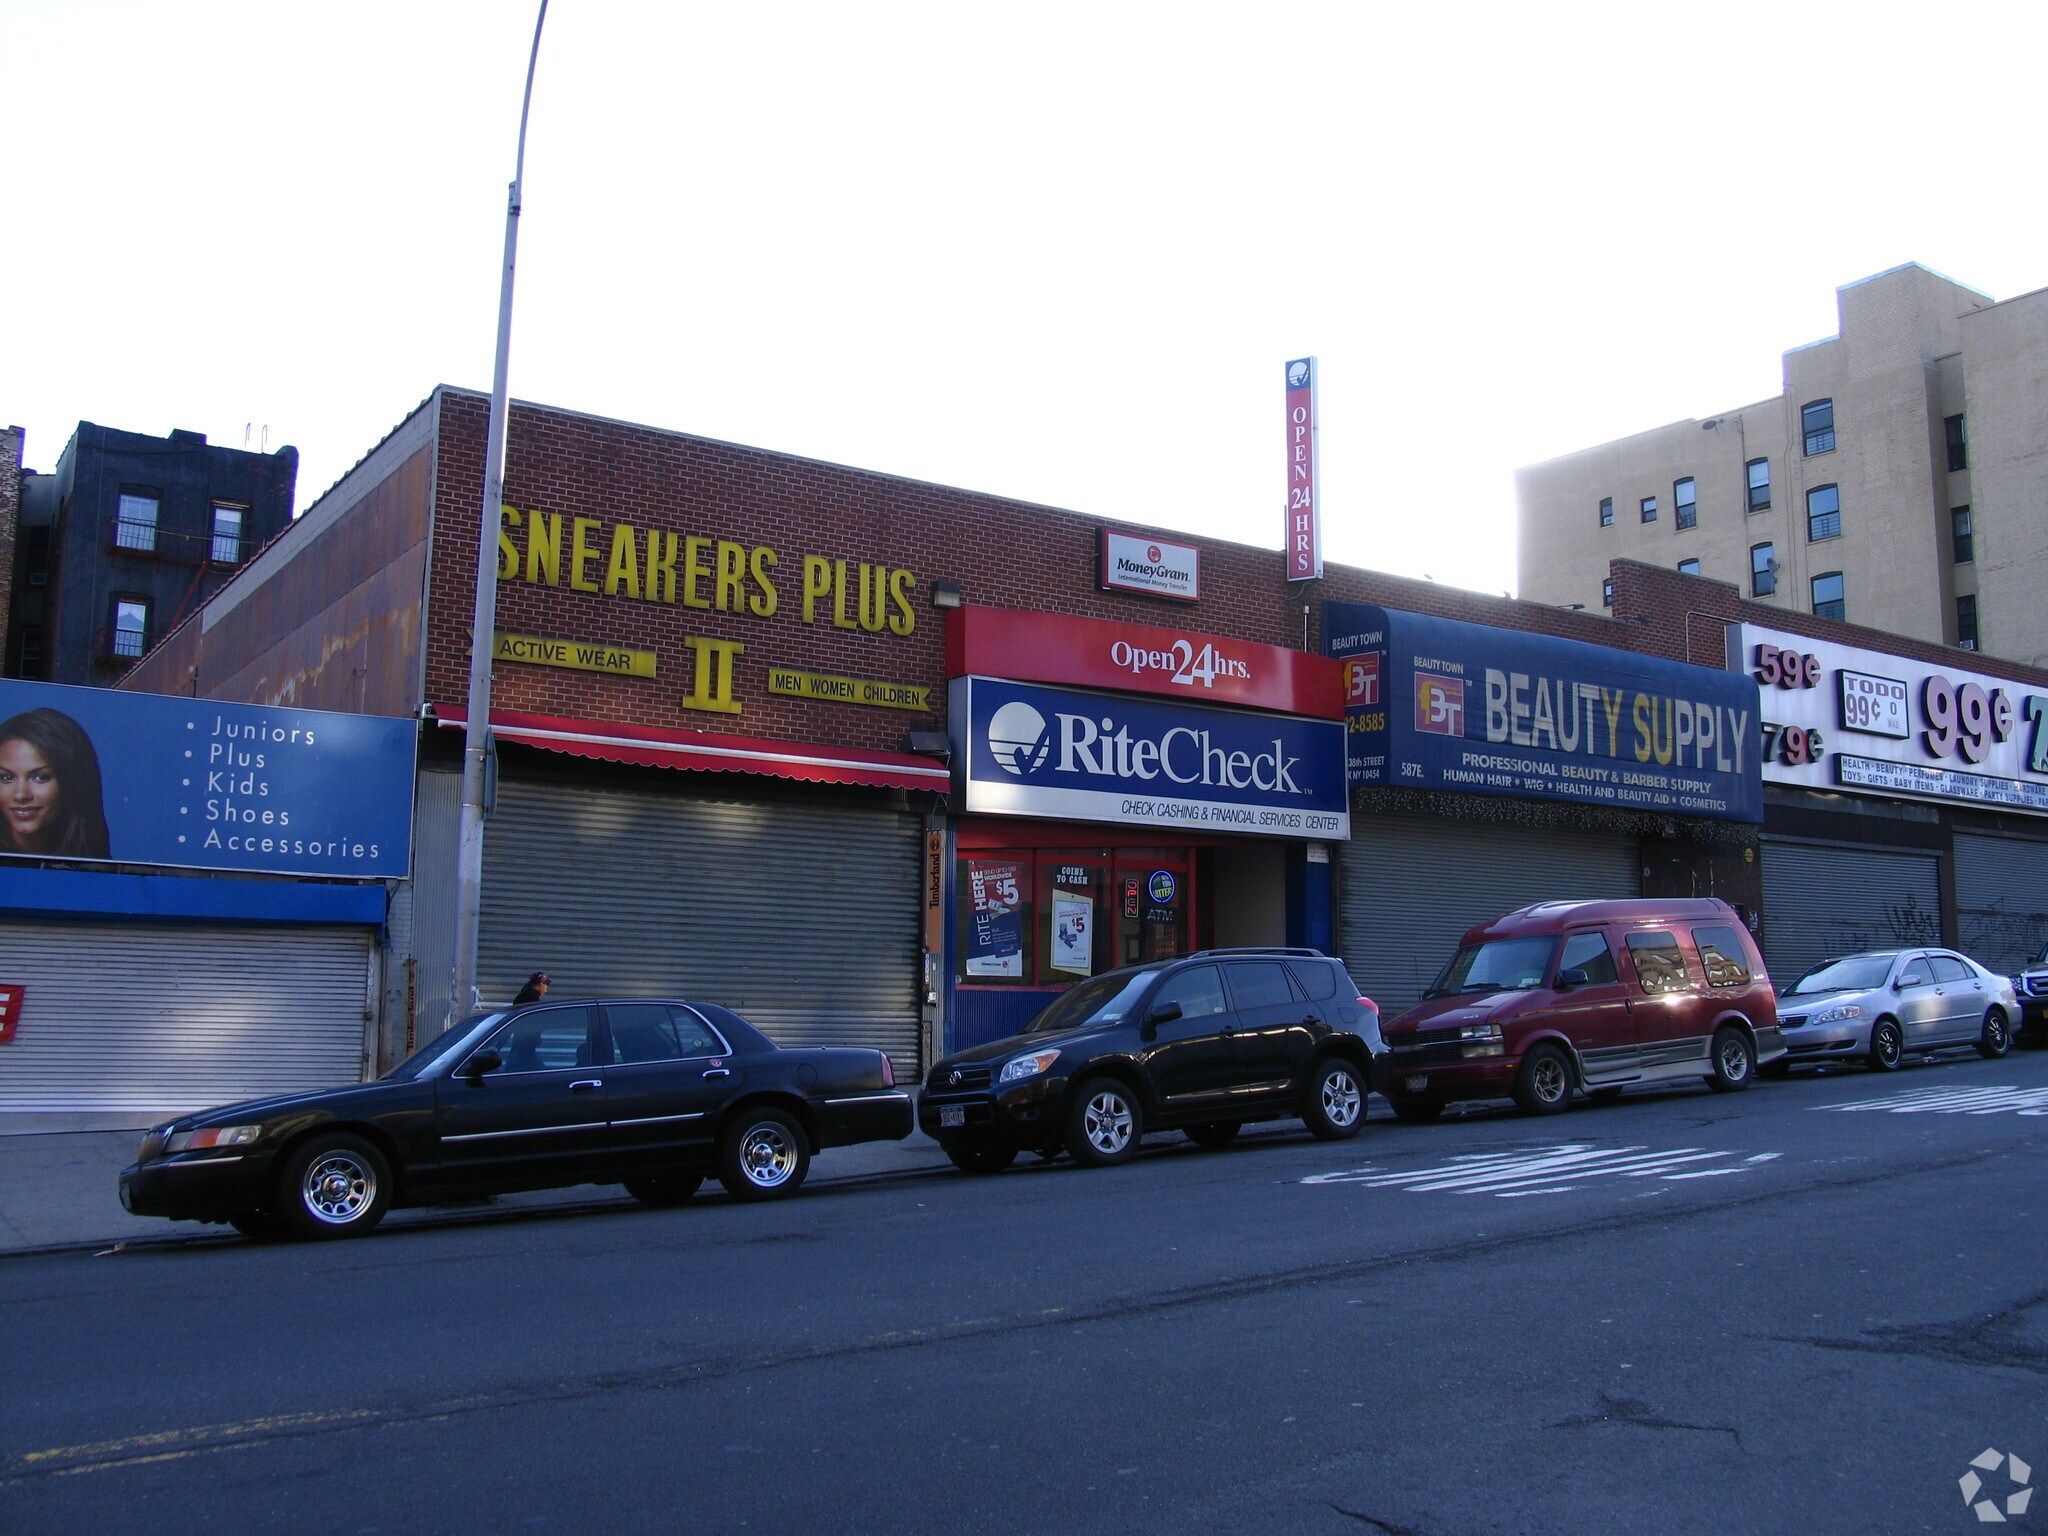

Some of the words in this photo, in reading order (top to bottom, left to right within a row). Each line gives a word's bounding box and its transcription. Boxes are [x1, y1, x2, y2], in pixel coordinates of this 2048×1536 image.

[1292, 406, 1307, 481] OPEN
[1291, 486, 1311, 510] 24
[1295, 514, 1309, 571] HRS
[497, 504, 778, 617] SNEAKERS
[802, 554, 916, 637] PLUS
[1117, 558, 1189, 581] MoneyGram
[1118, 574, 1151, 585] International
[1151, 579, 1168, 589] Money
[1169, 582, 1188, 591] Transfer
[499, 639, 567, 662] ACTIVE
[576, 648, 631, 669] WEAR
[1332, 634, 1358, 650] BEAUTY
[1359, 631, 1383, 645] TOWN
[683, 635, 745, 715] II
[1413, 656, 1441, 671] BEAUTY
[1441, 660, 1464, 675] TOWN
[1754, 644, 1821, 690] 59¢
[775, 673, 801, 691] MEN
[810, 678, 855, 698] WOMEN
[863, 685, 920, 706] CHILDREN
[1845, 676, 1905, 700] TODO
[211, 715, 315, 746] Juniors
[1485, 668, 1623, 758] BEAUTY
[1633, 693, 1748, 774] SUPPLY
[1921, 675, 2013, 765] 99¢
[209, 742, 265, 769] Plus
[1055, 712, 1302, 794] RiteCheck
[1761, 721, 1824, 766] 79¢
[1352, 770, 1361, 780] NY
[1362, 769, 1380, 780] 10454
[1363, 755, 1385, 767] STREET
[1462, 752, 1558, 776] PROFESSIONAL
[1561, 764, 1608, 782] BEAUTY
[1611, 771, 1619, 784] &
[1623, 773, 1668, 789] BARBER
[1670, 778, 1711, 794] SUPPLY
[1843, 757, 1870, 770] HEALTH
[1876, 762, 1903, 775] BEAUTY
[1908, 768, 1944, 782] PERFUMES
[1949, 773, 1978, 787] LAUNDRY
[1979, 779, 2009, 791] SUPPLIES
[207, 770, 269, 797] Kids
[1443, 769, 1484, 785] HUMAN
[1487, 773, 1512, 787] HAIR
[1523, 778, 1544, 791] WIG
[1556, 782, 1592, 796] HEALTH
[1594, 786, 1615, 798] AND
[1617, 789, 1652, 802] BEAUTY
[1653, 793, 1669, 805] AID
[1679, 796, 1727, 811] COSMETICS
[1843, 770, 1862, 782] TOYS
[1867, 773, 1888, 785] GIFTS
[1893, 777, 1912, 789] BABY
[1914, 780, 1934, 792] ITEMS
[1940, 784, 1979, 798] GLASSWARE
[1984, 789, 2003, 801] PARTY
[2005, 792, 2034, 804] SUPPLIES
[206, 798, 290, 826] Shoes
[1121, 800, 1156, 816] CHECK
[1157, 803, 1200, 820] CASHING
[1201, 810, 1209, 821] &
[1210, 807, 1257, 825] FINANCIAL
[1259, 811, 1301, 828] SERVICES
[1305, 815, 1339, 831] CENTER
[204, 828, 379, 859] Accessories
[929, 853, 940, 910] Timberland
[1056, 875, 1066, 883] TO
[1069, 875, 1088, 885] CASH
[1061, 866, 1084, 875] COINS
[971, 870, 987, 911] HERE
[996, 878, 1019, 905] $5
[1127, 881, 1138, 915] OPEN
[976, 914, 992, 946] RITE
[1072, 917, 1085, 934] $5
[1147, 908, 1173, 922] ATM
